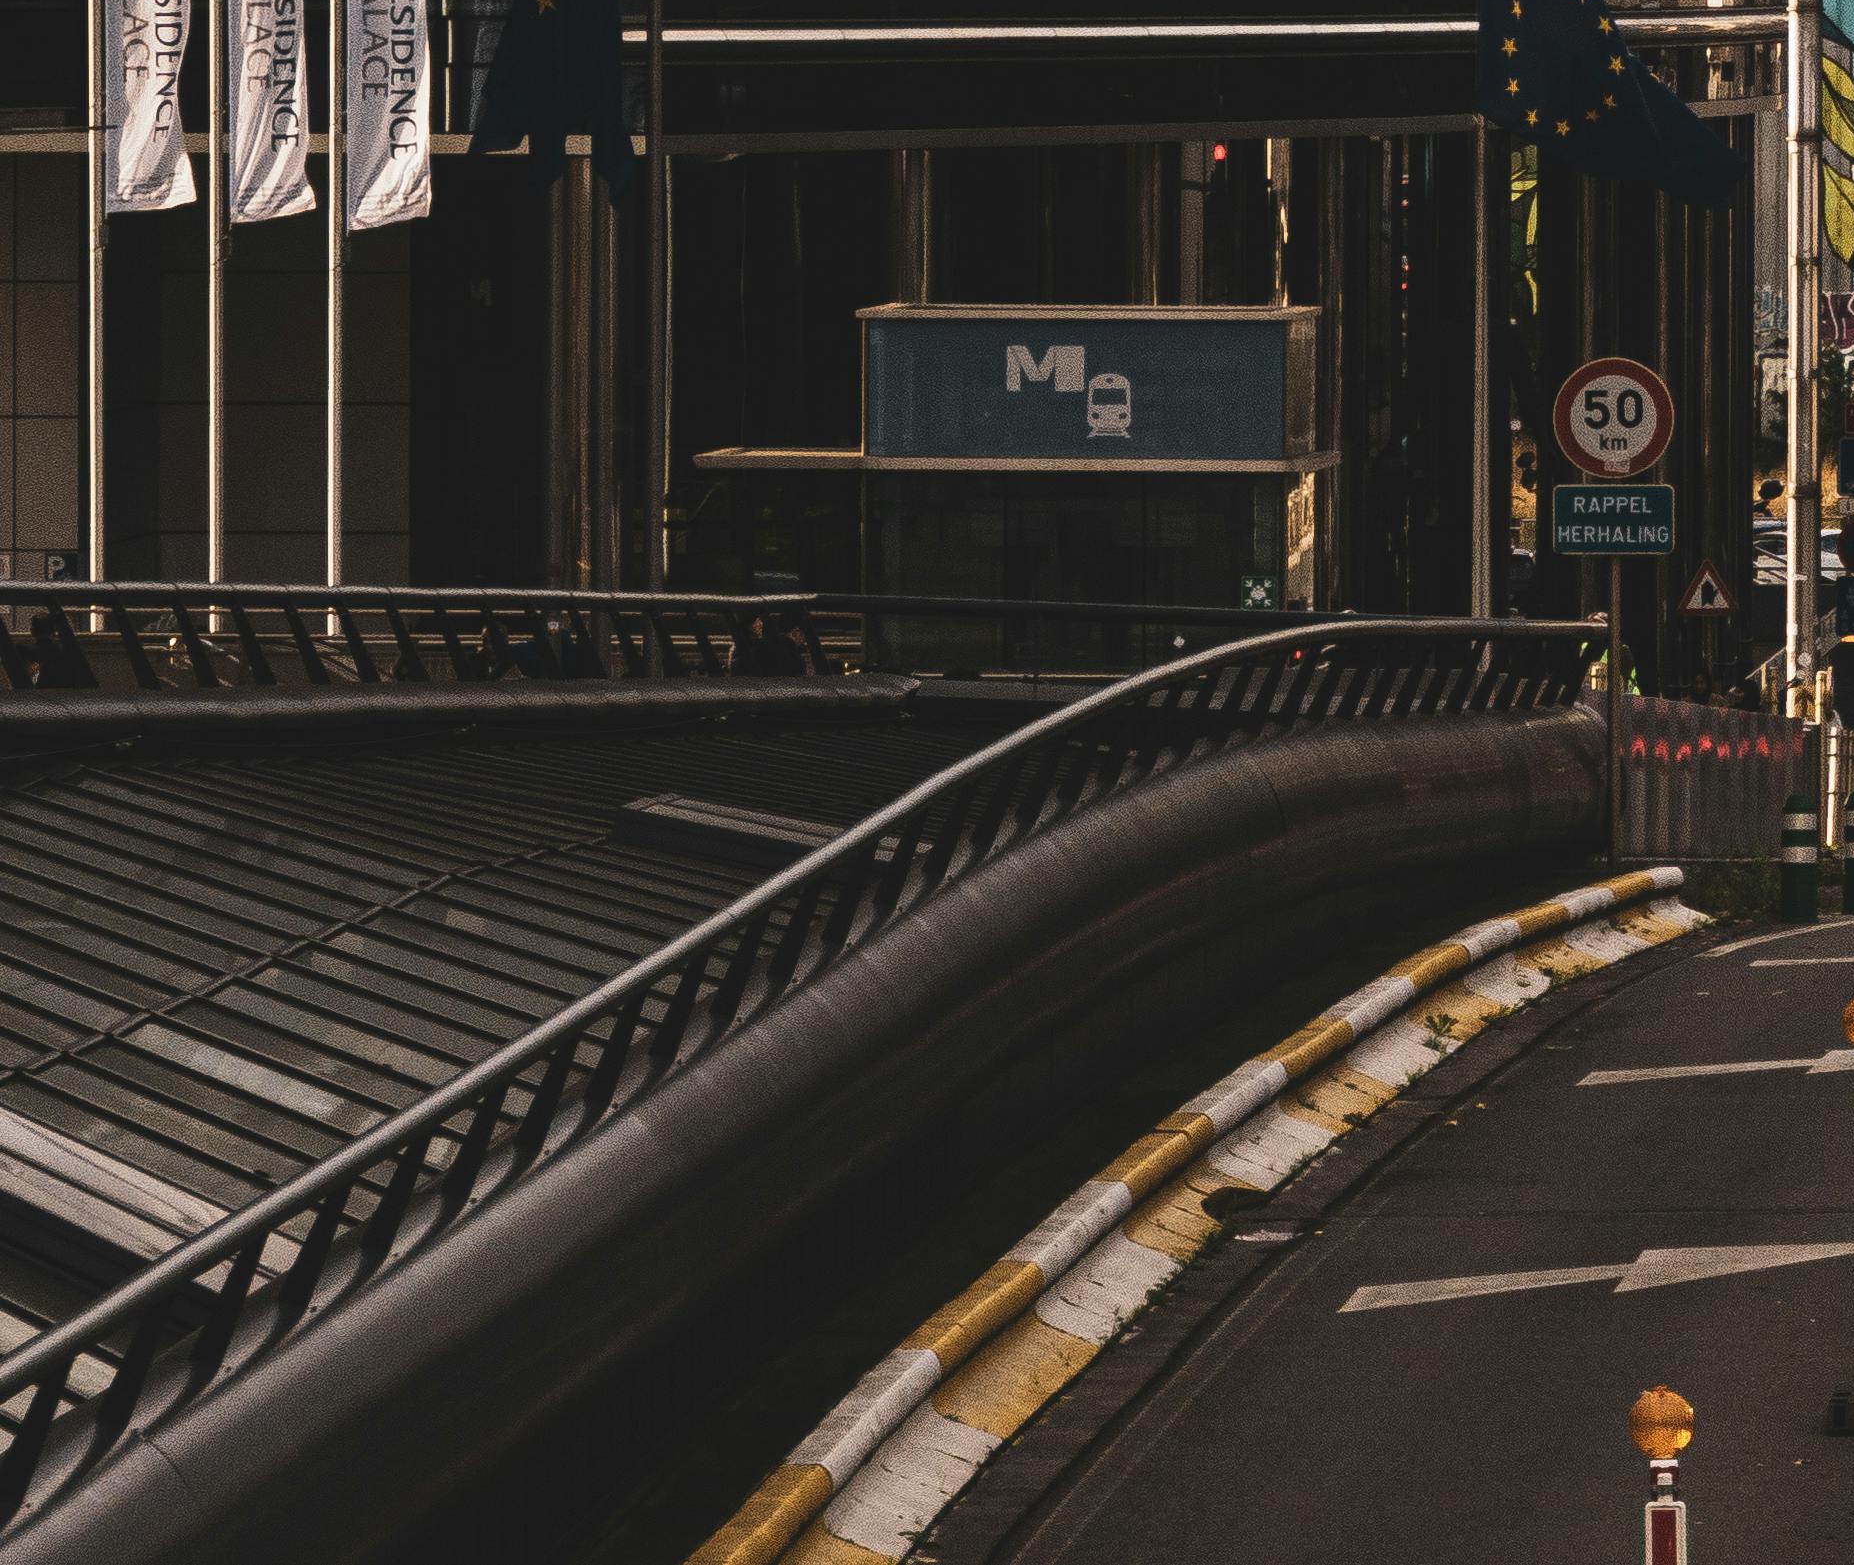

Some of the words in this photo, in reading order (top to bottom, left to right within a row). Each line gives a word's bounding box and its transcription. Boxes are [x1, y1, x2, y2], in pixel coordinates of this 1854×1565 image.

[1583, 389, 1644, 430] 50
[1599, 435, 1628, 451] km
[1573, 496, 1653, 514] RAPPEL
[1558, 525, 1669, 544] HERHALING
